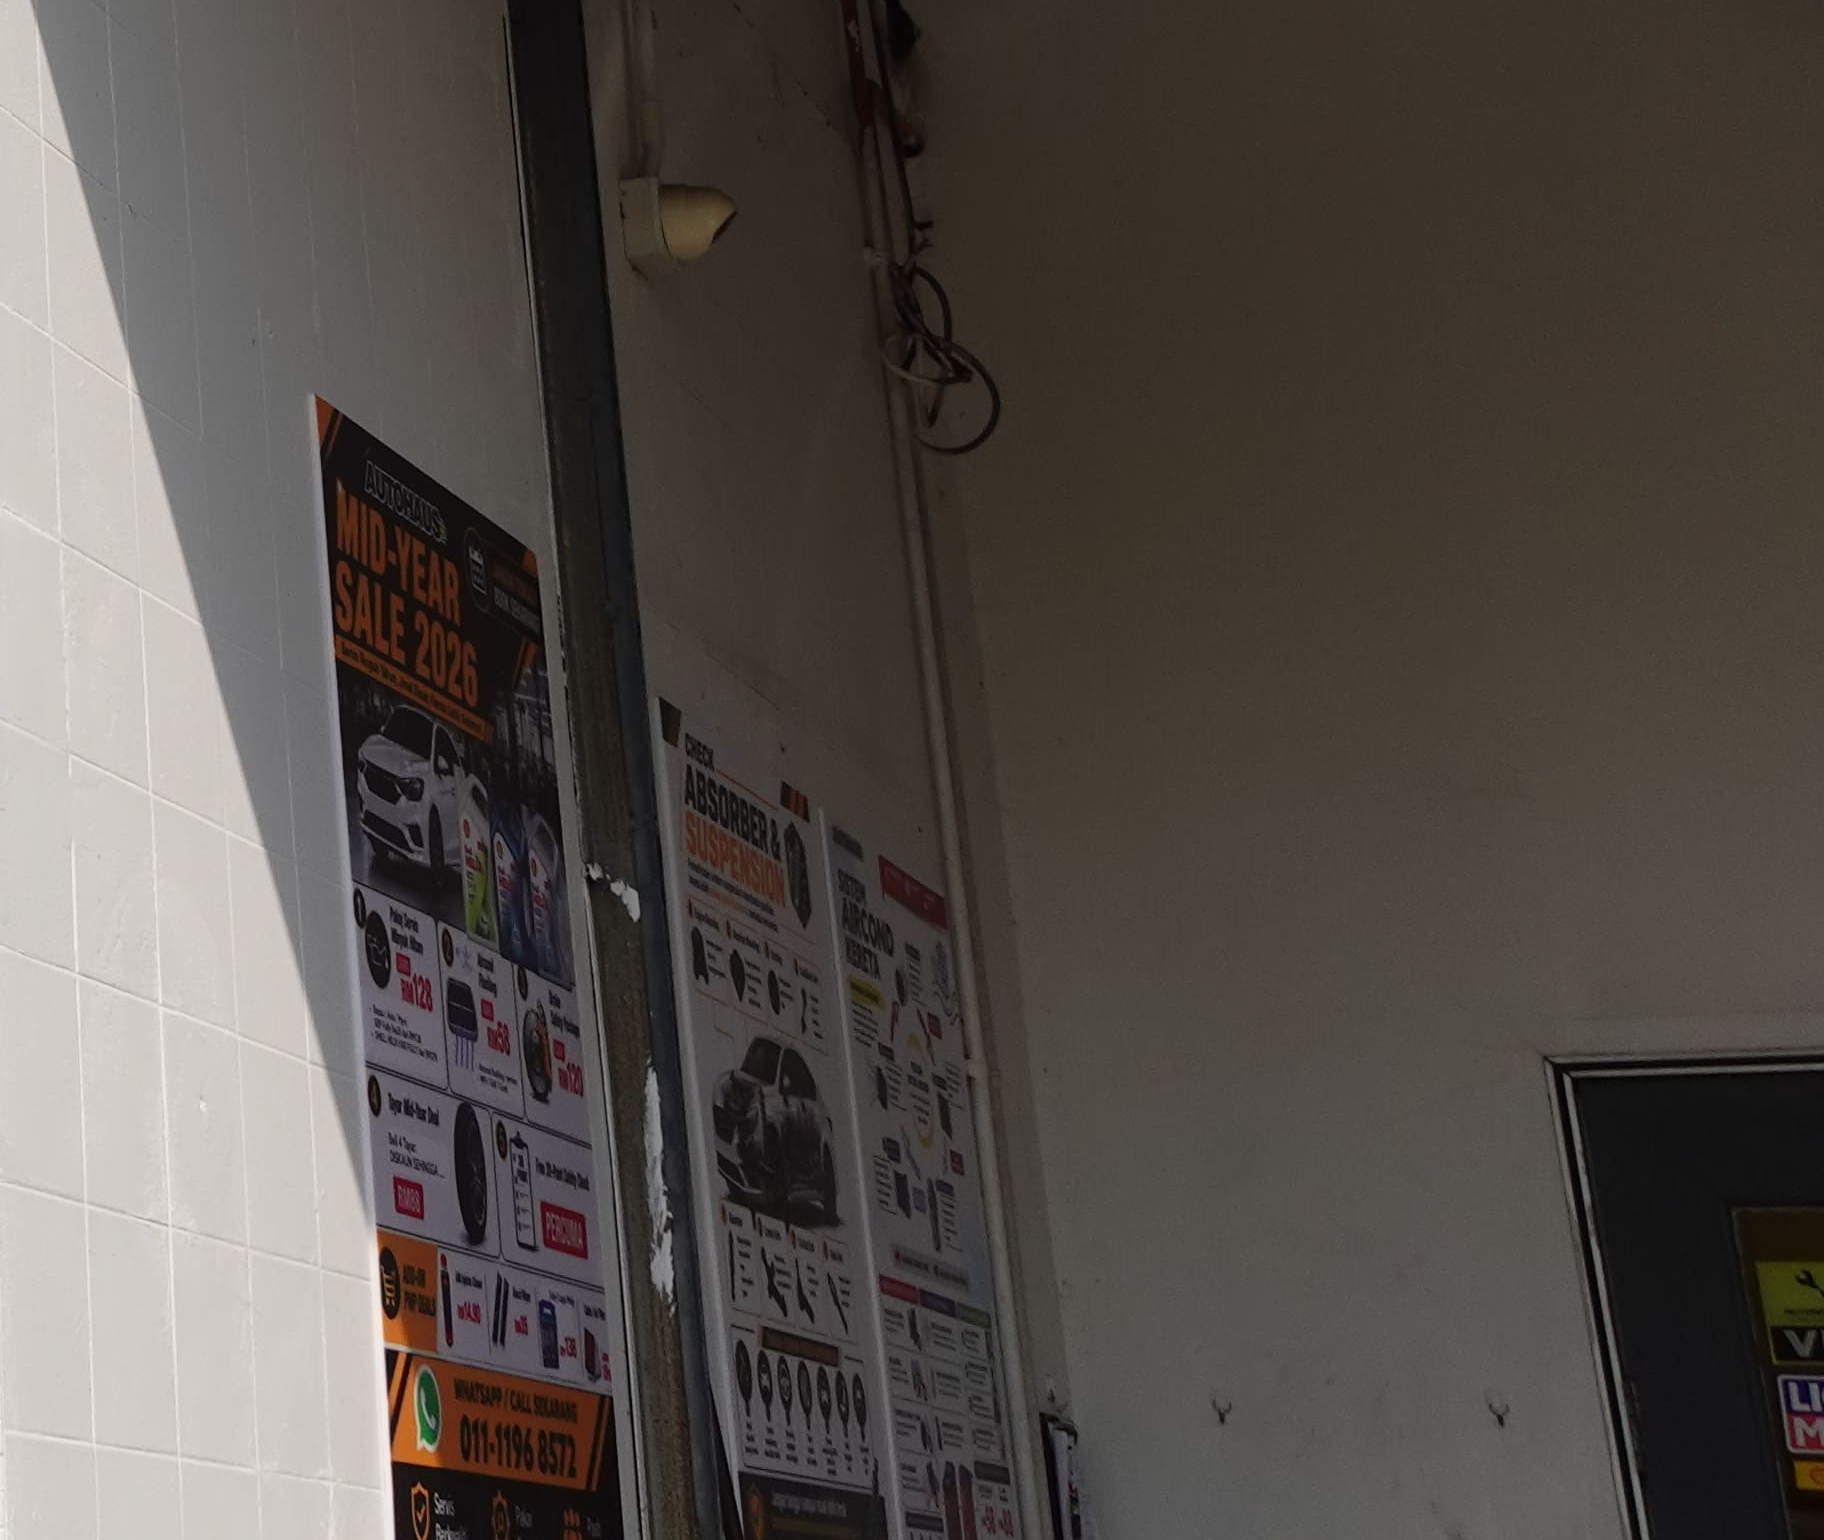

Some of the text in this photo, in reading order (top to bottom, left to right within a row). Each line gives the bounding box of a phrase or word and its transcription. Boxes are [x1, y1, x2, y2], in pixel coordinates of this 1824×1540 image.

[363, 459, 444, 542] AUTOHAUS
[336, 478, 463, 627] MID-YEAR
[335, 562, 406, 667] SALE
[414, 610, 479, 708] 2026
[684, 763, 769, 851] ABSORBER
[685, 810, 786, 908] SUSPENSION
[453, 1378, 502, 1406] WHATSAPP
[508, 1388, 532, 1413] CALL
[459, 1414, 578, 1479] 011-1196 8572
